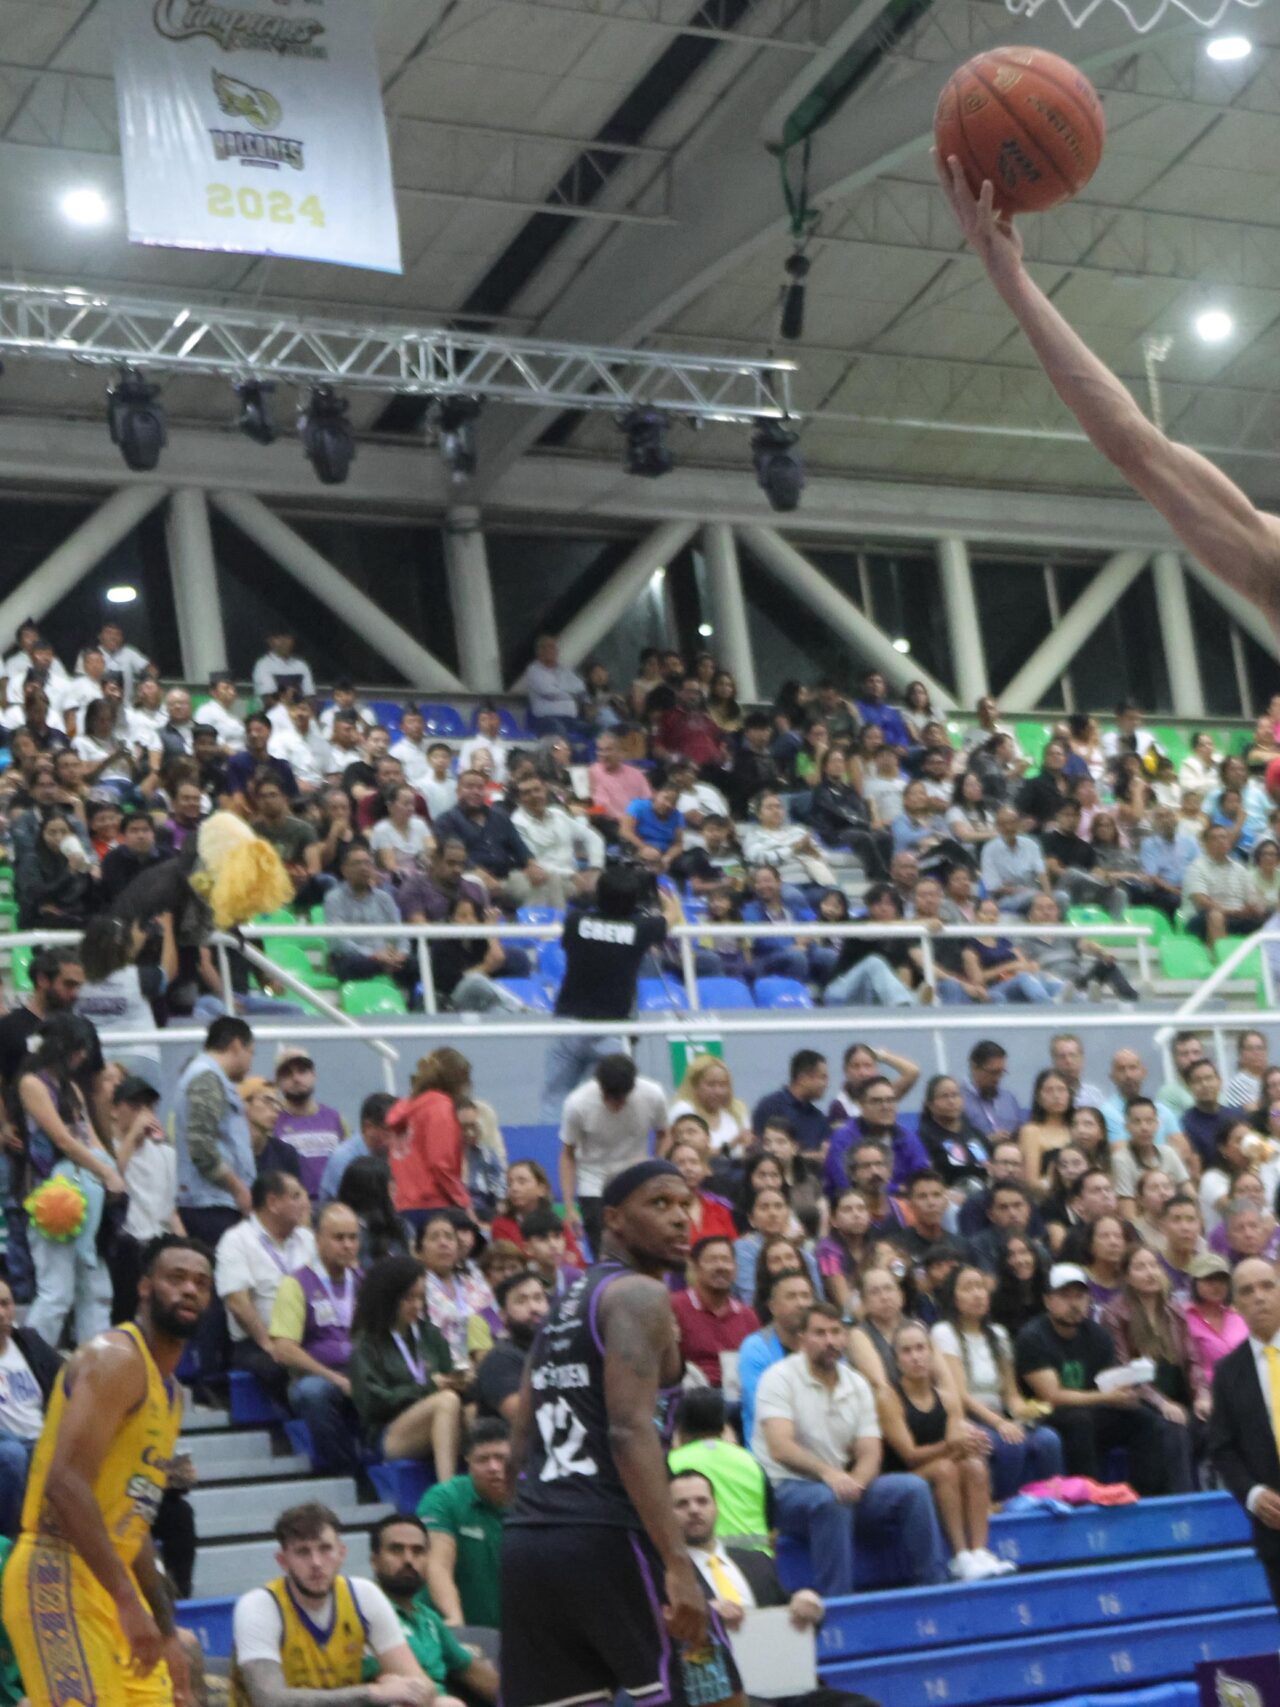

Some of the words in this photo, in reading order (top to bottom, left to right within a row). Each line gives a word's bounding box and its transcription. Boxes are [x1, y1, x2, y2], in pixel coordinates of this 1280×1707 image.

[207, 183, 326, 228] 2024
[577, 917, 636, 946] CREW
[535, 1396, 598, 1482] 12
